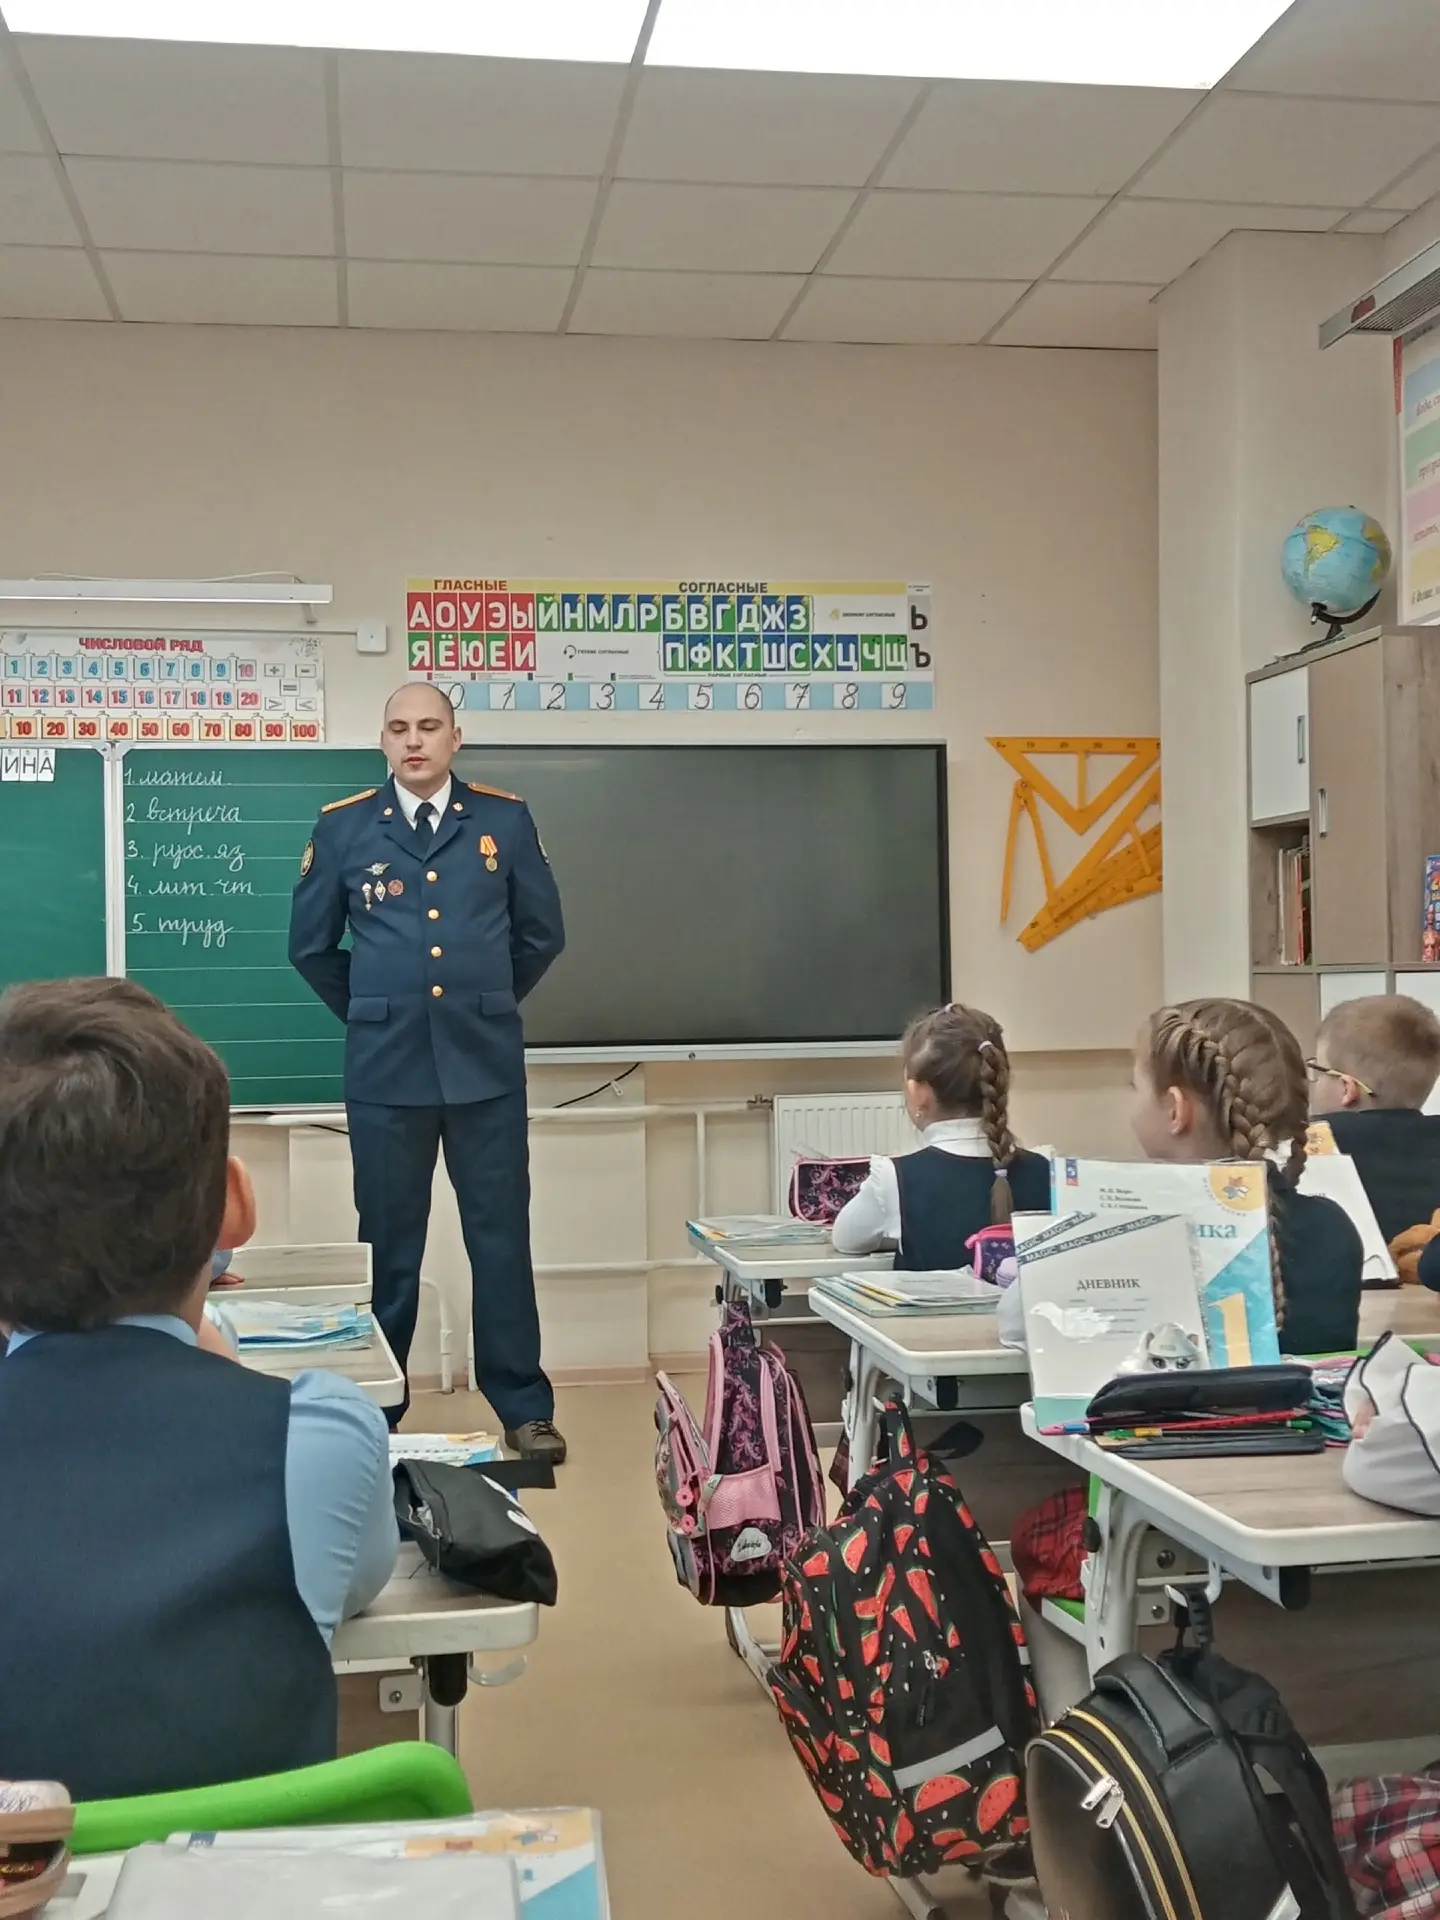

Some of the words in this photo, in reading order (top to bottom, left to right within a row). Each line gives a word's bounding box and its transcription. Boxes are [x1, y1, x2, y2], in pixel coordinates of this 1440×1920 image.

[433, 580, 508, 592] ГЛАСНЫЕ
[678, 581, 768, 594] СОГЛАСНЫЕ
[910, 604, 928, 630] Ь
[78, 637, 167, 651] ЧИСЛОВОЙ
[169, 638, 205, 652] РЯД
[909, 642, 931, 668] Ъ
[10, 660, 18, 675] 1
[37, 660, 48, 675] 2
[62, 660, 73, 675] 3
[88, 661, 98, 675] 4
[114, 661, 124, 676] 5
[140, 662, 149, 676] 6
[166, 662, 176, 676] 7
[191, 663, 201, 677] 8
[216, 663, 226, 677] 9
[238, 664, 254, 678] 10
[7, 688, 22, 703] 11
[32, 688, 49, 703] 12
[58, 689, 75, 703] 13
[86, 689, 103, 704] 14
[111, 690, 128, 704] 15
[138, 690, 155, 704] 16
[164, 691, 181, 705] 17
[190, 691, 206, 705] 18
[215, 691, 232, 705] 19
[241, 691, 258, 706] 20
[448, 682, 465, 710] 0
[502, 682, 516, 710] 1
[546, 682, 566, 710] 2
[596, 682, 615, 710] 3
[649, 682, 665, 710] 4
[694, 682, 713, 710] 5
[744, 682, 762, 710] 6
[792, 682, 810, 710] 7
[841, 682, 859, 710] 8
[889, 682, 907, 710] 9
[16, 721, 32, 735] 10
[47, 721, 65, 736] 20
[78, 721, 96, 736] 30
[110, 722, 129, 736] 40
[141, 722, 159, 736] 50
[172, 722, 190, 737] 60
[204, 723, 222, 737] 70
[234, 723, 253, 738] 80
[265, 723, 284, 738] 90
[292, 724, 317, 738] 100
[5, 756, 54, 774] ИНА
[126, 802, 136, 822] 2
[146, 796, 243, 836] встреча
[158, 916, 234, 948] труд
[1025, 1247, 1058, 1262] MAGIC
[1059, 1236, 1092, 1252] MAGIC
[1093, 1225, 1126, 1242] MAGIC
[1125, 1215, 1159, 1232] MAGIC
[1042, 1223, 1072, 1240] MAGIC
[1076, 1278, 1142, 1292] ДНЕВНИК
